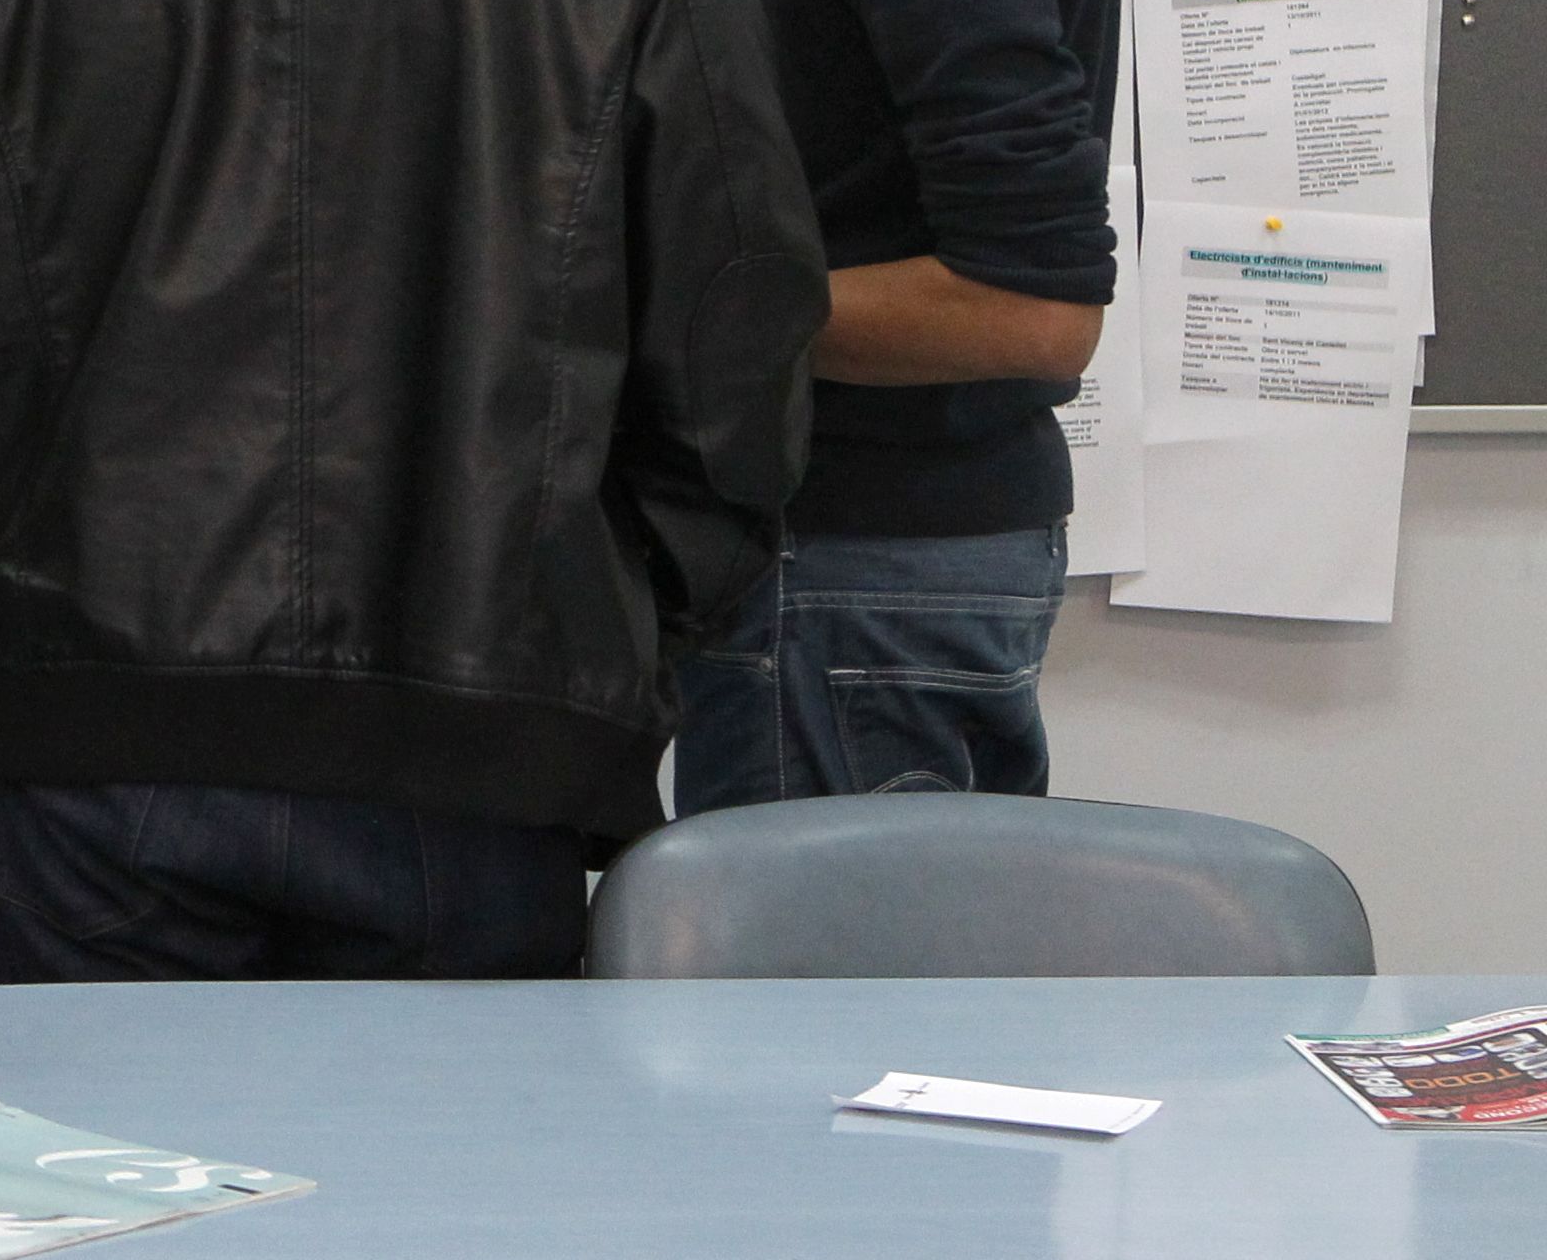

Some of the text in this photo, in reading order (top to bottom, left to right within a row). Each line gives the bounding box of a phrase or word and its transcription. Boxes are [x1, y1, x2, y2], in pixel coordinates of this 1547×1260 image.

[1190, 251, 1383, 273] Electricista d'edificis (manteniment
[1407, 1069, 1521, 1090] TODO
